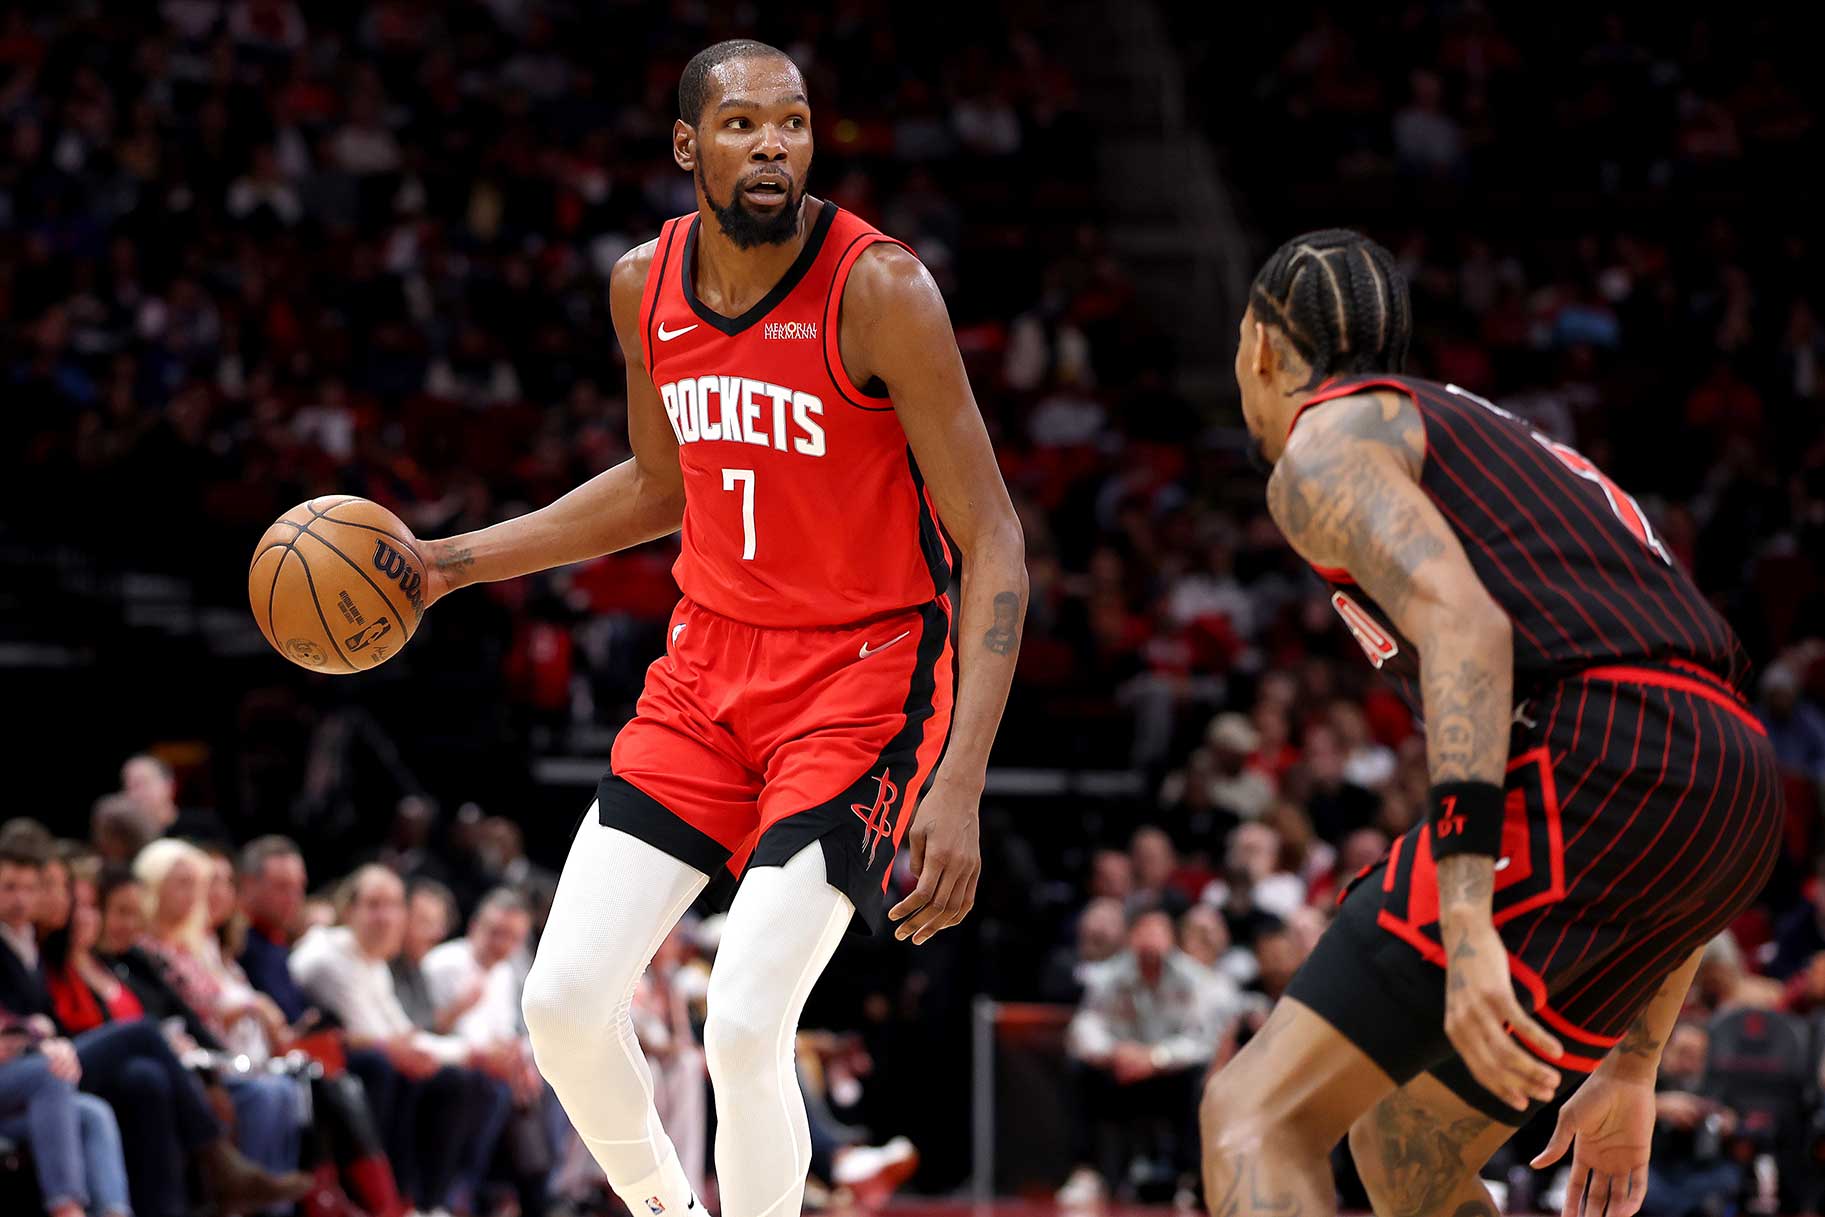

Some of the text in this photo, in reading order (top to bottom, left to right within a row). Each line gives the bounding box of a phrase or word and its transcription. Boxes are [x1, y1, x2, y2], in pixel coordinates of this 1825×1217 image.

[765, 321, 817, 332] MEMORIAL
[765, 330, 816, 339] HERMANN
[660, 375, 826, 457] ROCKETS
[721, 468, 756, 560] 7
